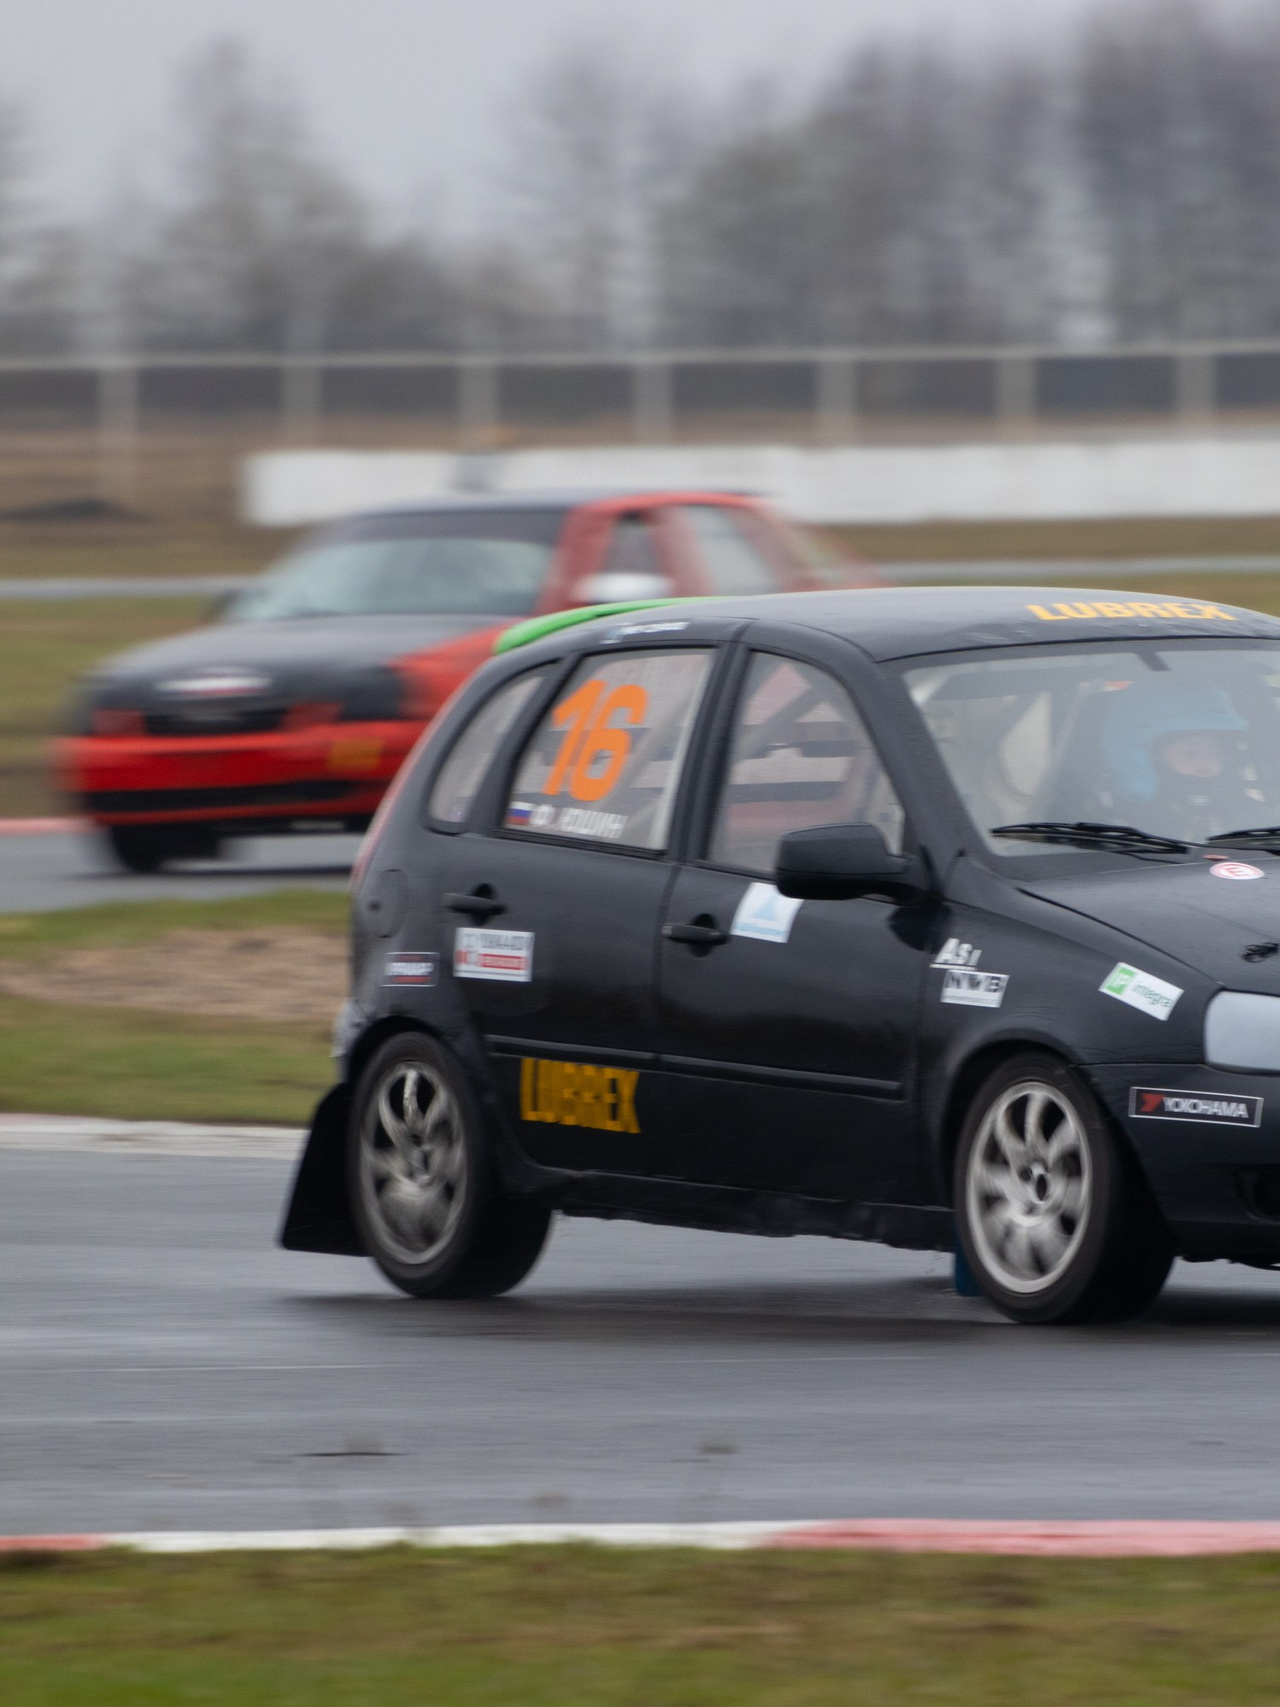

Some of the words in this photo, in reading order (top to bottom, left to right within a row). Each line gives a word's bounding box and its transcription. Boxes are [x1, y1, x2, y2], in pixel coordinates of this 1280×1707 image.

[1024, 602, 1238, 621] LUBREX
[541, 679, 647, 802] 16
[521, 1057, 641, 1133] LUBREX
[1162, 1096, 1249, 1119] YOKOHAMA
